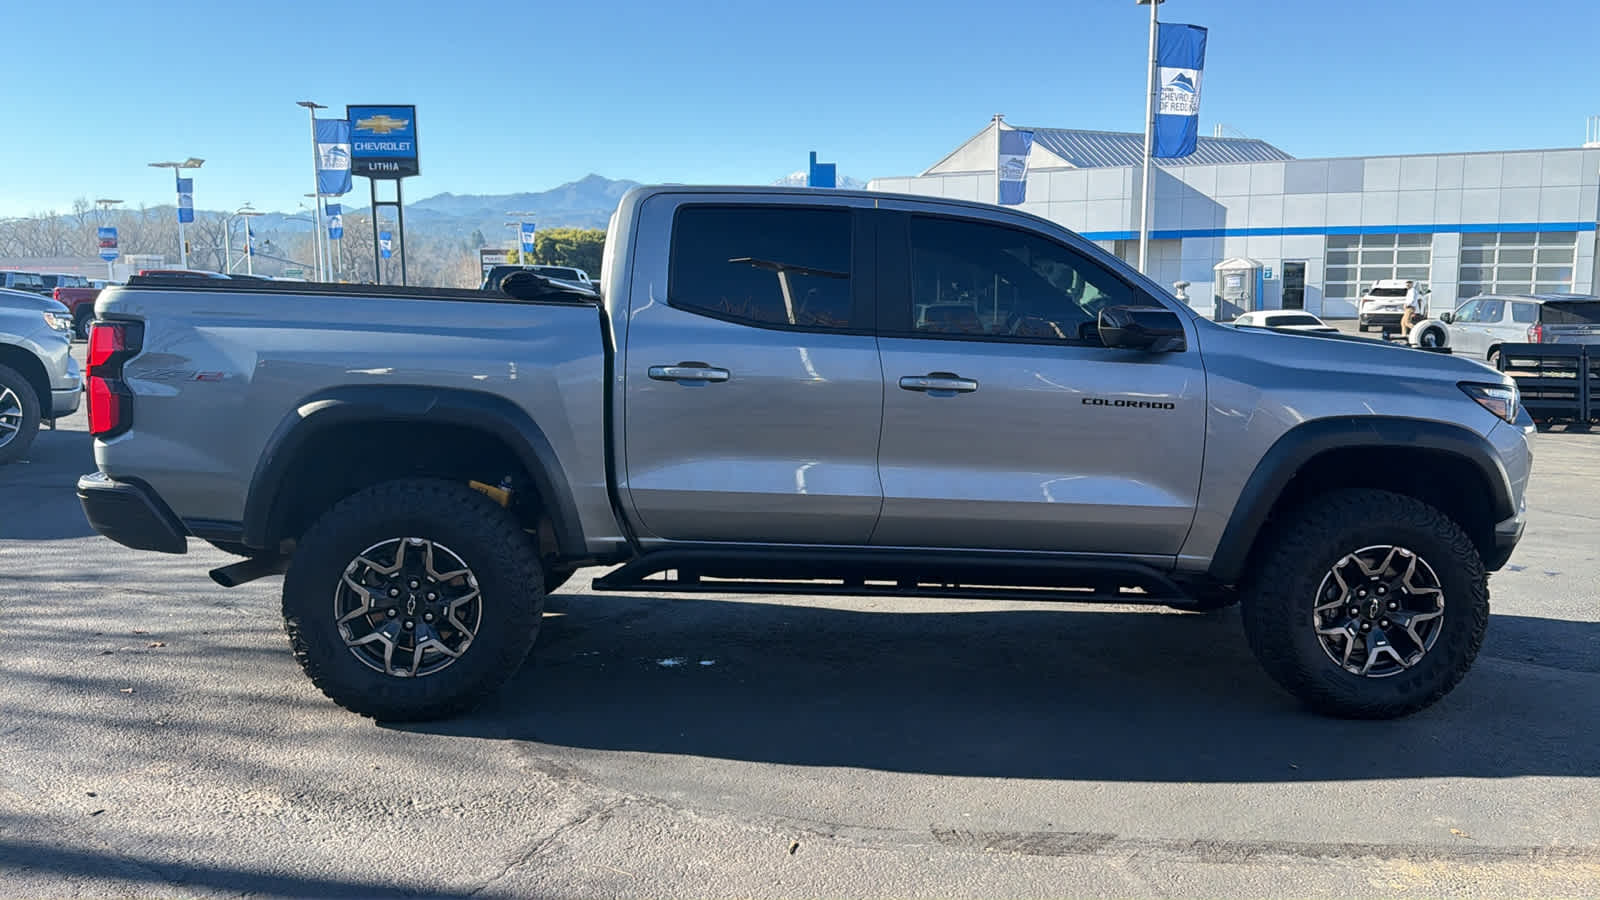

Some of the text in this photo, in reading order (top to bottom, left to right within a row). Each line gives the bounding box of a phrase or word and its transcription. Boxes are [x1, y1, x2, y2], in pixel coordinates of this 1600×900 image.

[354, 142, 411, 151] CHEVROLET
[368, 162, 399, 171] LITHIA
[1081, 398, 1176, 410] COLORADO
